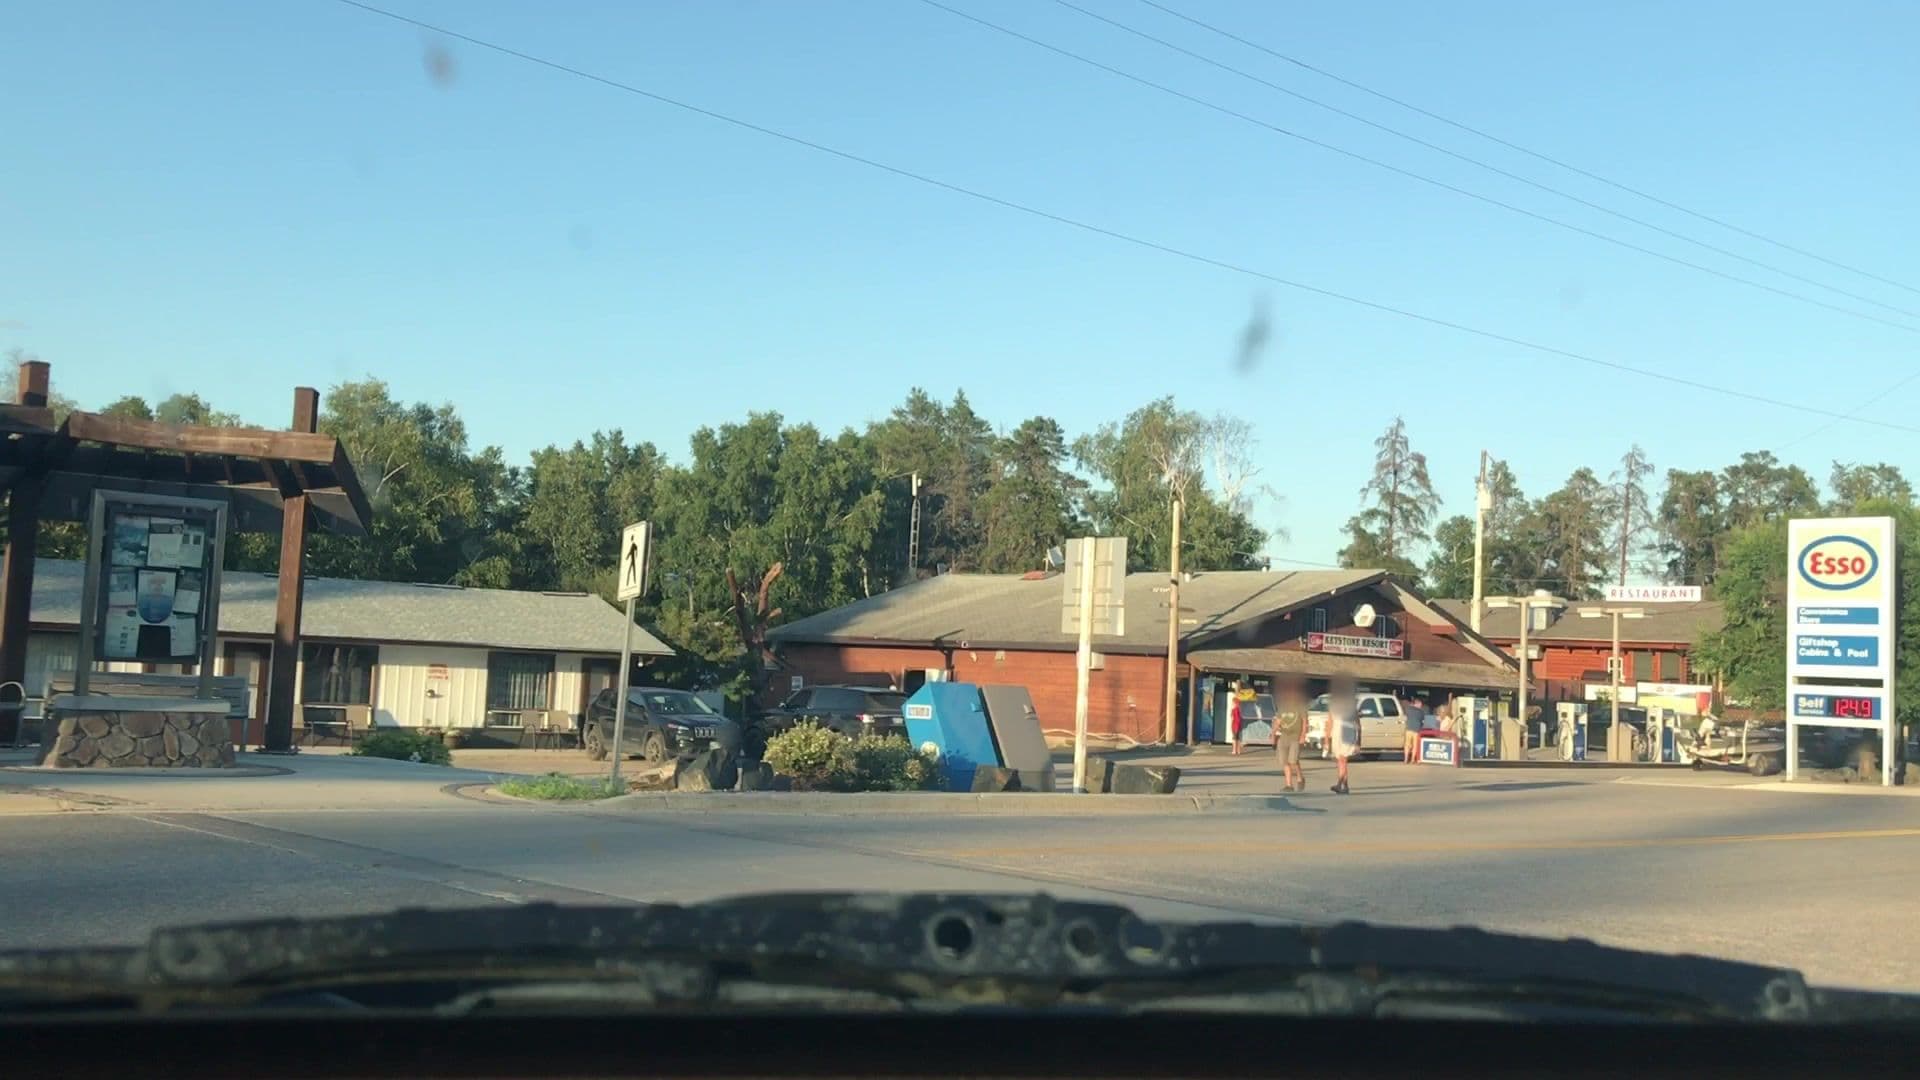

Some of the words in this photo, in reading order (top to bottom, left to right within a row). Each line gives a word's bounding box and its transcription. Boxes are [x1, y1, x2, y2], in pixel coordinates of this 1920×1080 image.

[1809, 551, 1866, 576] Esso
[1610, 588, 1696, 600] RESTAURANT
[1325, 635, 1361, 648] KEYSTONE
[1362, 639, 1389, 649] RESORT
[1799, 637, 1840, 649] Giftshop
[1799, 648, 1830, 657] Cabins
[1847, 648, 1869, 658] Pool
[1797, 696, 1825, 709] Self
